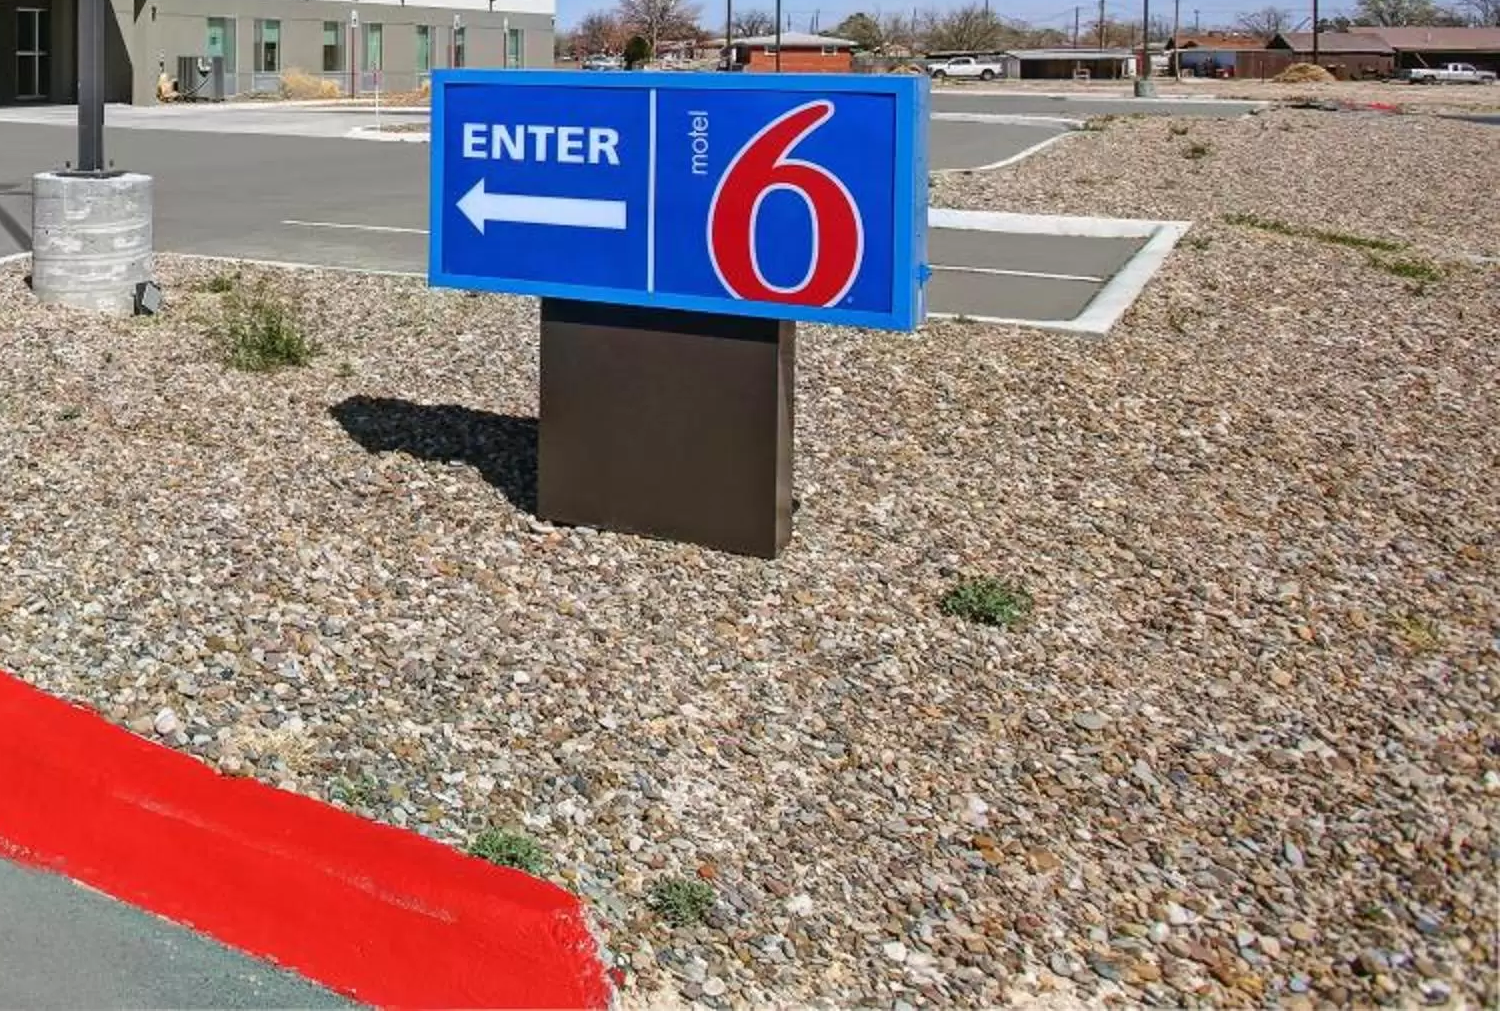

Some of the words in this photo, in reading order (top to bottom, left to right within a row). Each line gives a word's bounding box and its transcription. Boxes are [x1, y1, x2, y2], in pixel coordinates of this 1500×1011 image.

[462, 122, 620, 166] ENTER
[687, 110, 709, 175] motel
[706, 99, 865, 308] 6
